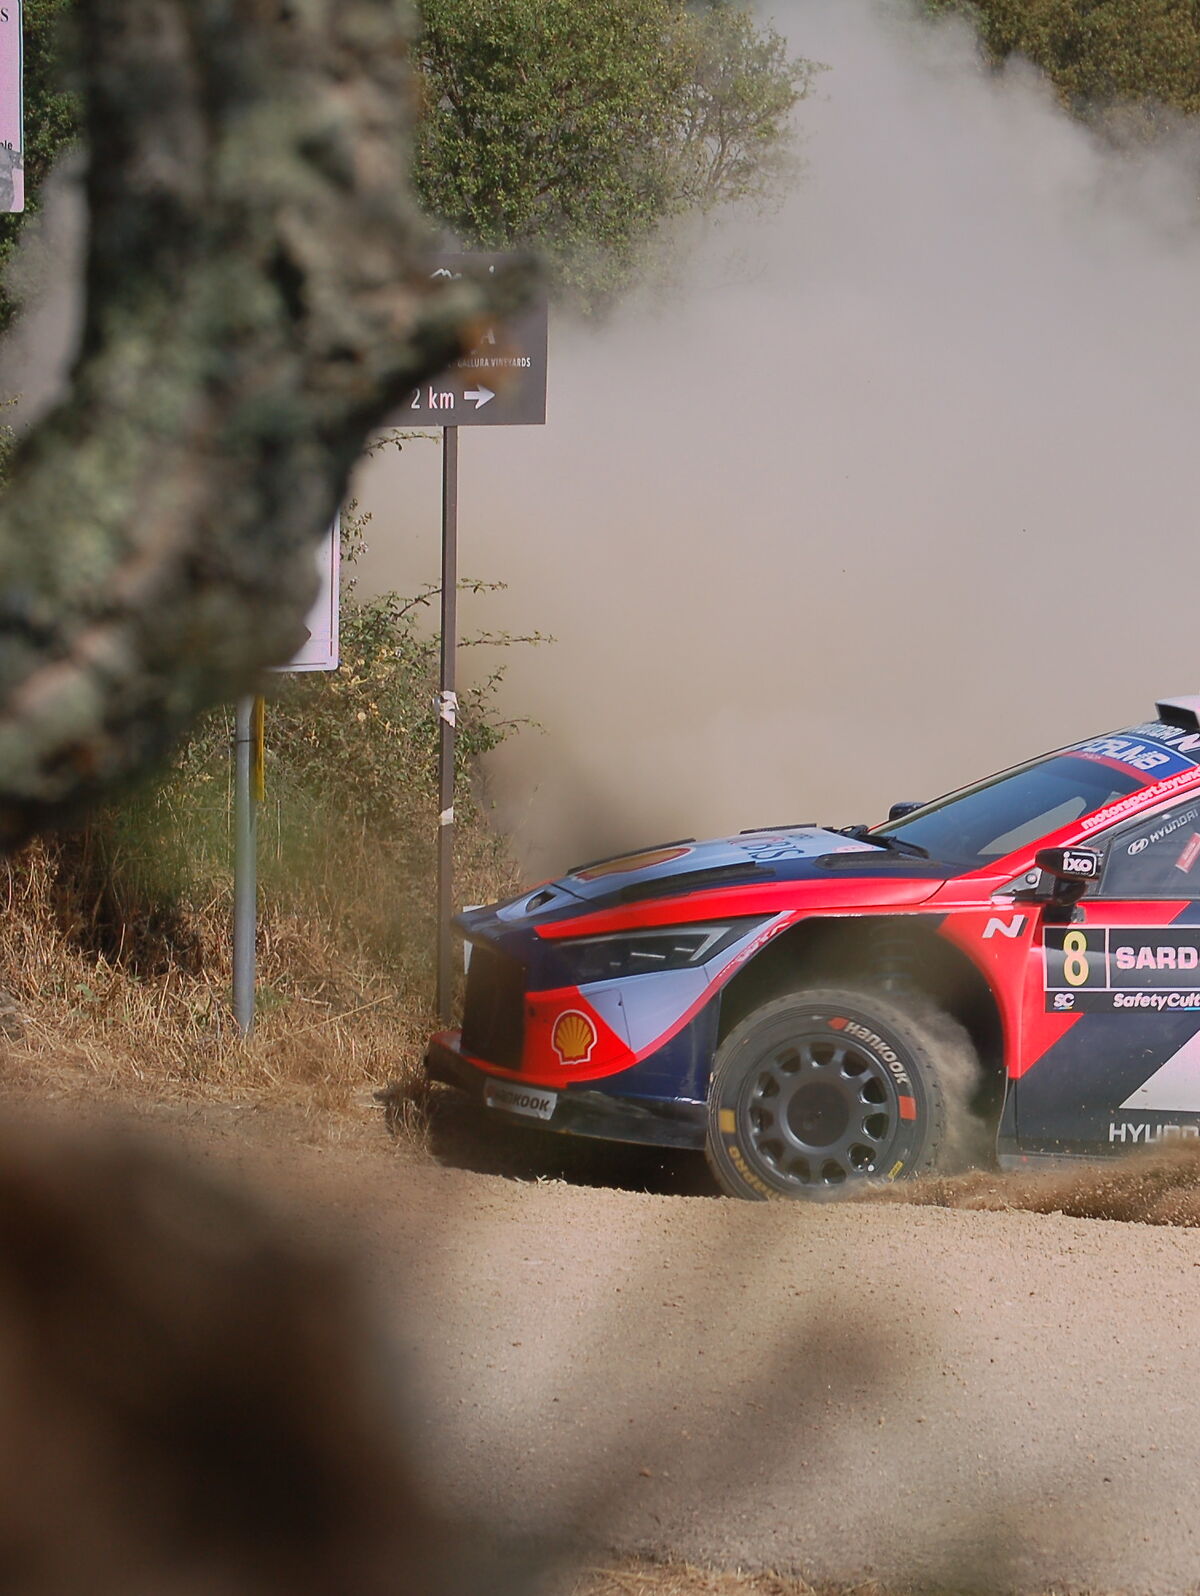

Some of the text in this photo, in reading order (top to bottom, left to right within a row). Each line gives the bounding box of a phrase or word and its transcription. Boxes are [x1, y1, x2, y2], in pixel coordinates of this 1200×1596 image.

[429, 386, 454, 409] km
[1150, 809, 1199, 843] HYUNDAI
[1063, 930, 1090, 987] 8
[1053, 993, 1075, 1008] SC
